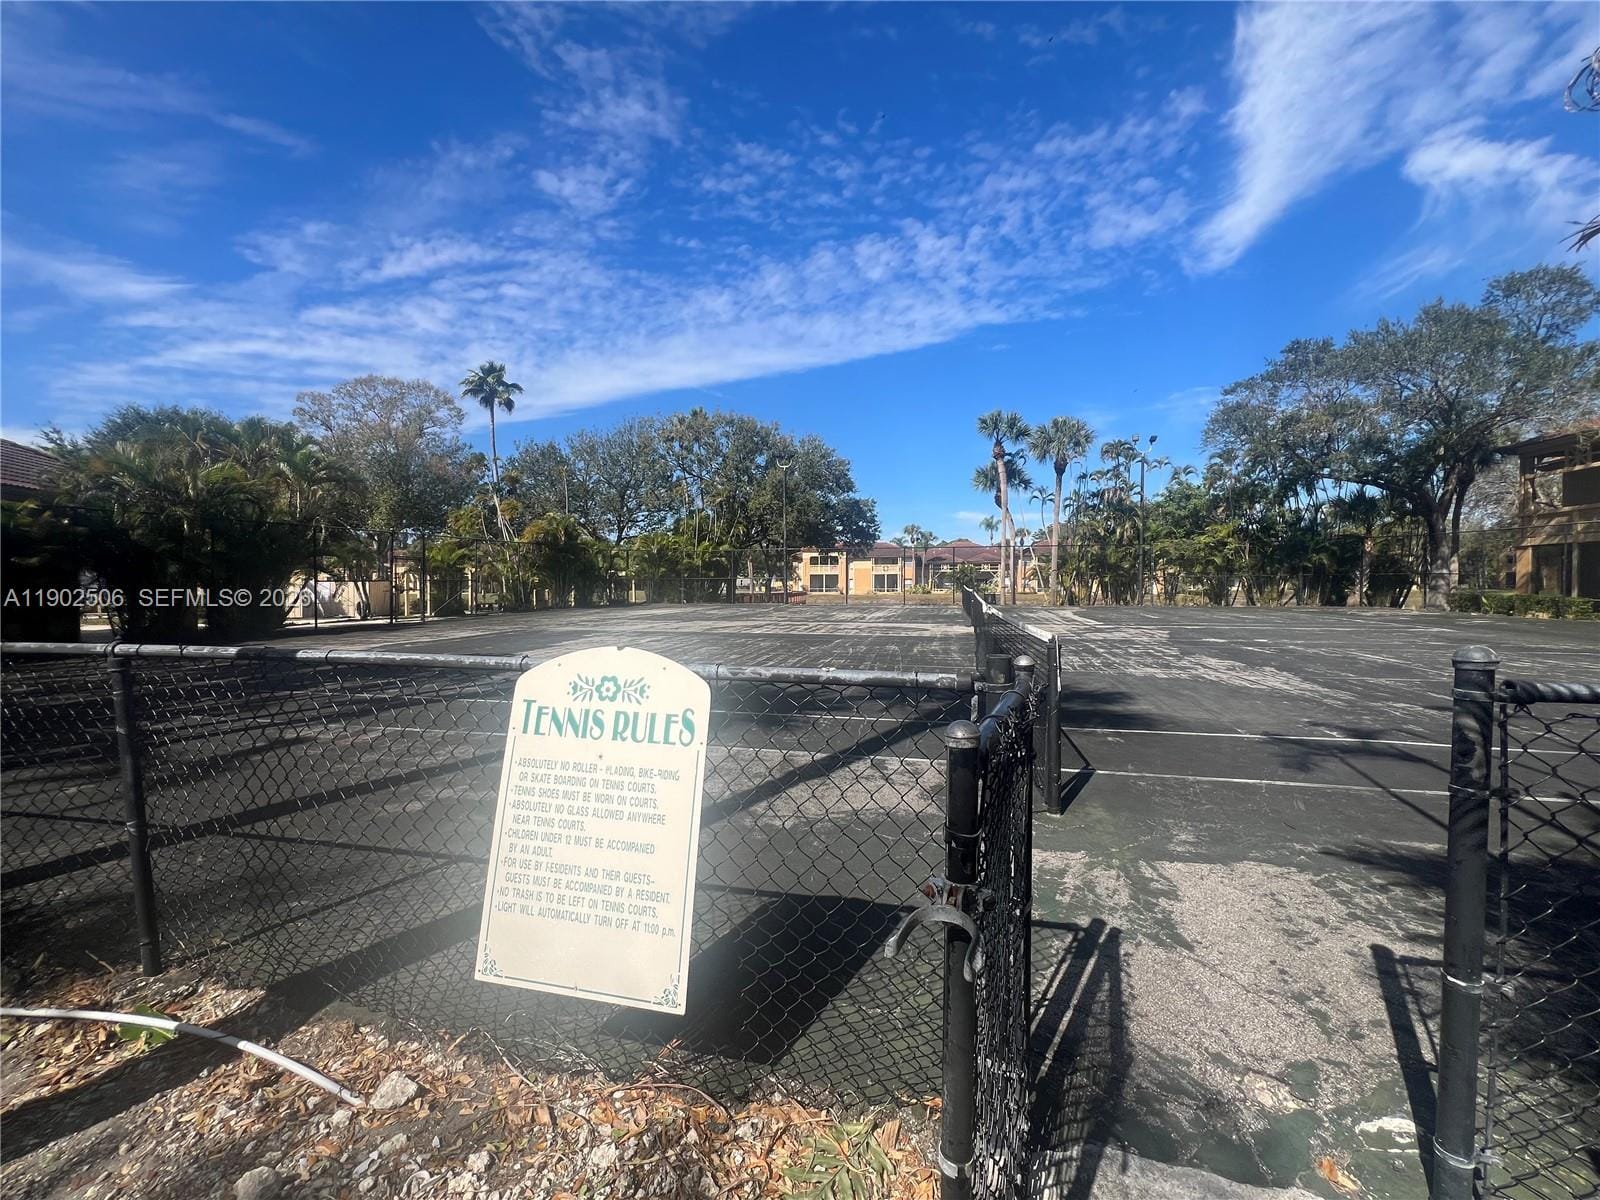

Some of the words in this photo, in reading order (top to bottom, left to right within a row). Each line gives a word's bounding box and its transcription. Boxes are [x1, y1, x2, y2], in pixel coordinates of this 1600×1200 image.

[522, 699, 605, 740] TENNIS
[611, 708, 696, 747] RULES
[517, 758, 558, 770] ABSOLUTELY
[560, 761, 570, 770] NO
[572, 762, 598, 773] ROLLER
[519, 772, 528, 781] OR
[531, 773, 552, 784] SKATE
[554, 774, 587, 787] BOARDING
[589, 778, 599, 788] ON
[602, 779, 625, 791] TENNIS
[627, 782, 657, 794] COURTS.
[513, 785, 536, 796] TENNIS
[538, 787, 560, 799] SHOES
[562, 790, 580, 801] MUST
[582, 792, 592, 802] BE
[595, 793, 615, 805] WORN
[617, 795, 627, 805] ON
[629, 796, 659, 809] COURTS.
[512, 800, 552, 813] ABSOLUTELY
[554, 804, 565, 813] NO
[567, 805, 589, 816] GLASS
[592, 808, 624, 820] ALLOWED
[627, 811, 666, 825] ANYWHERE
[512, 814, 531, 825] NEAR
[533, 816, 554, 828] TENNIS
[558, 819, 586, 831] COURTS.
[508, 828, 538, 840] CHILDREN
[540, 832, 562, 843] UNDER
[565, 835, 572, 845] 12
[574, 836, 592, 847] MUST
[595, 838, 604, 848] BE
[607, 840, 655, 854] ACCOMPANIED
[508, 843, 518, 853] BY
[520, 845, 530, 854] AN
[503, 857, 517, 867] FOR
[519, 859, 532, 870] USE
[534, 861, 544, 871] BY
[584, 866, 598, 878] AND
[602, 869, 621, 880] THEIR
[505, 872, 530, 885] GUESTS
[532, 875, 550, 887] MUST
[553, 879, 563, 889] BE
[565, 880, 613, 895] ACCOMPANIED
[615, 886, 624, 896] BY
[627, 888, 633, 898] A
[635, 889, 670, 904] RESIDENT.
[500, 887, 509, 896] NO
[512, 888, 534, 900] TRASH
[536, 892, 542, 901] IS
[546, 892, 554, 902] TO
[557, 893, 566, 904] BE
[568, 895, 585, 906] LEFT
[588, 898, 598, 908] ON
[602, 900, 624, 913] TENNIS
[627, 904, 658, 918] COURTS.
[497, 902, 516, 913] LIGHT
[520, 904, 534, 916] WILL
[538, 906, 591, 923] AUTOMATICALLY
[594, 914, 612, 926] TURN
[615, 918, 629, 929] OFF
[632, 920, 641, 931] AT
[644, 922, 659, 935] 11:00
[662, 926, 676, 938] p.m.
